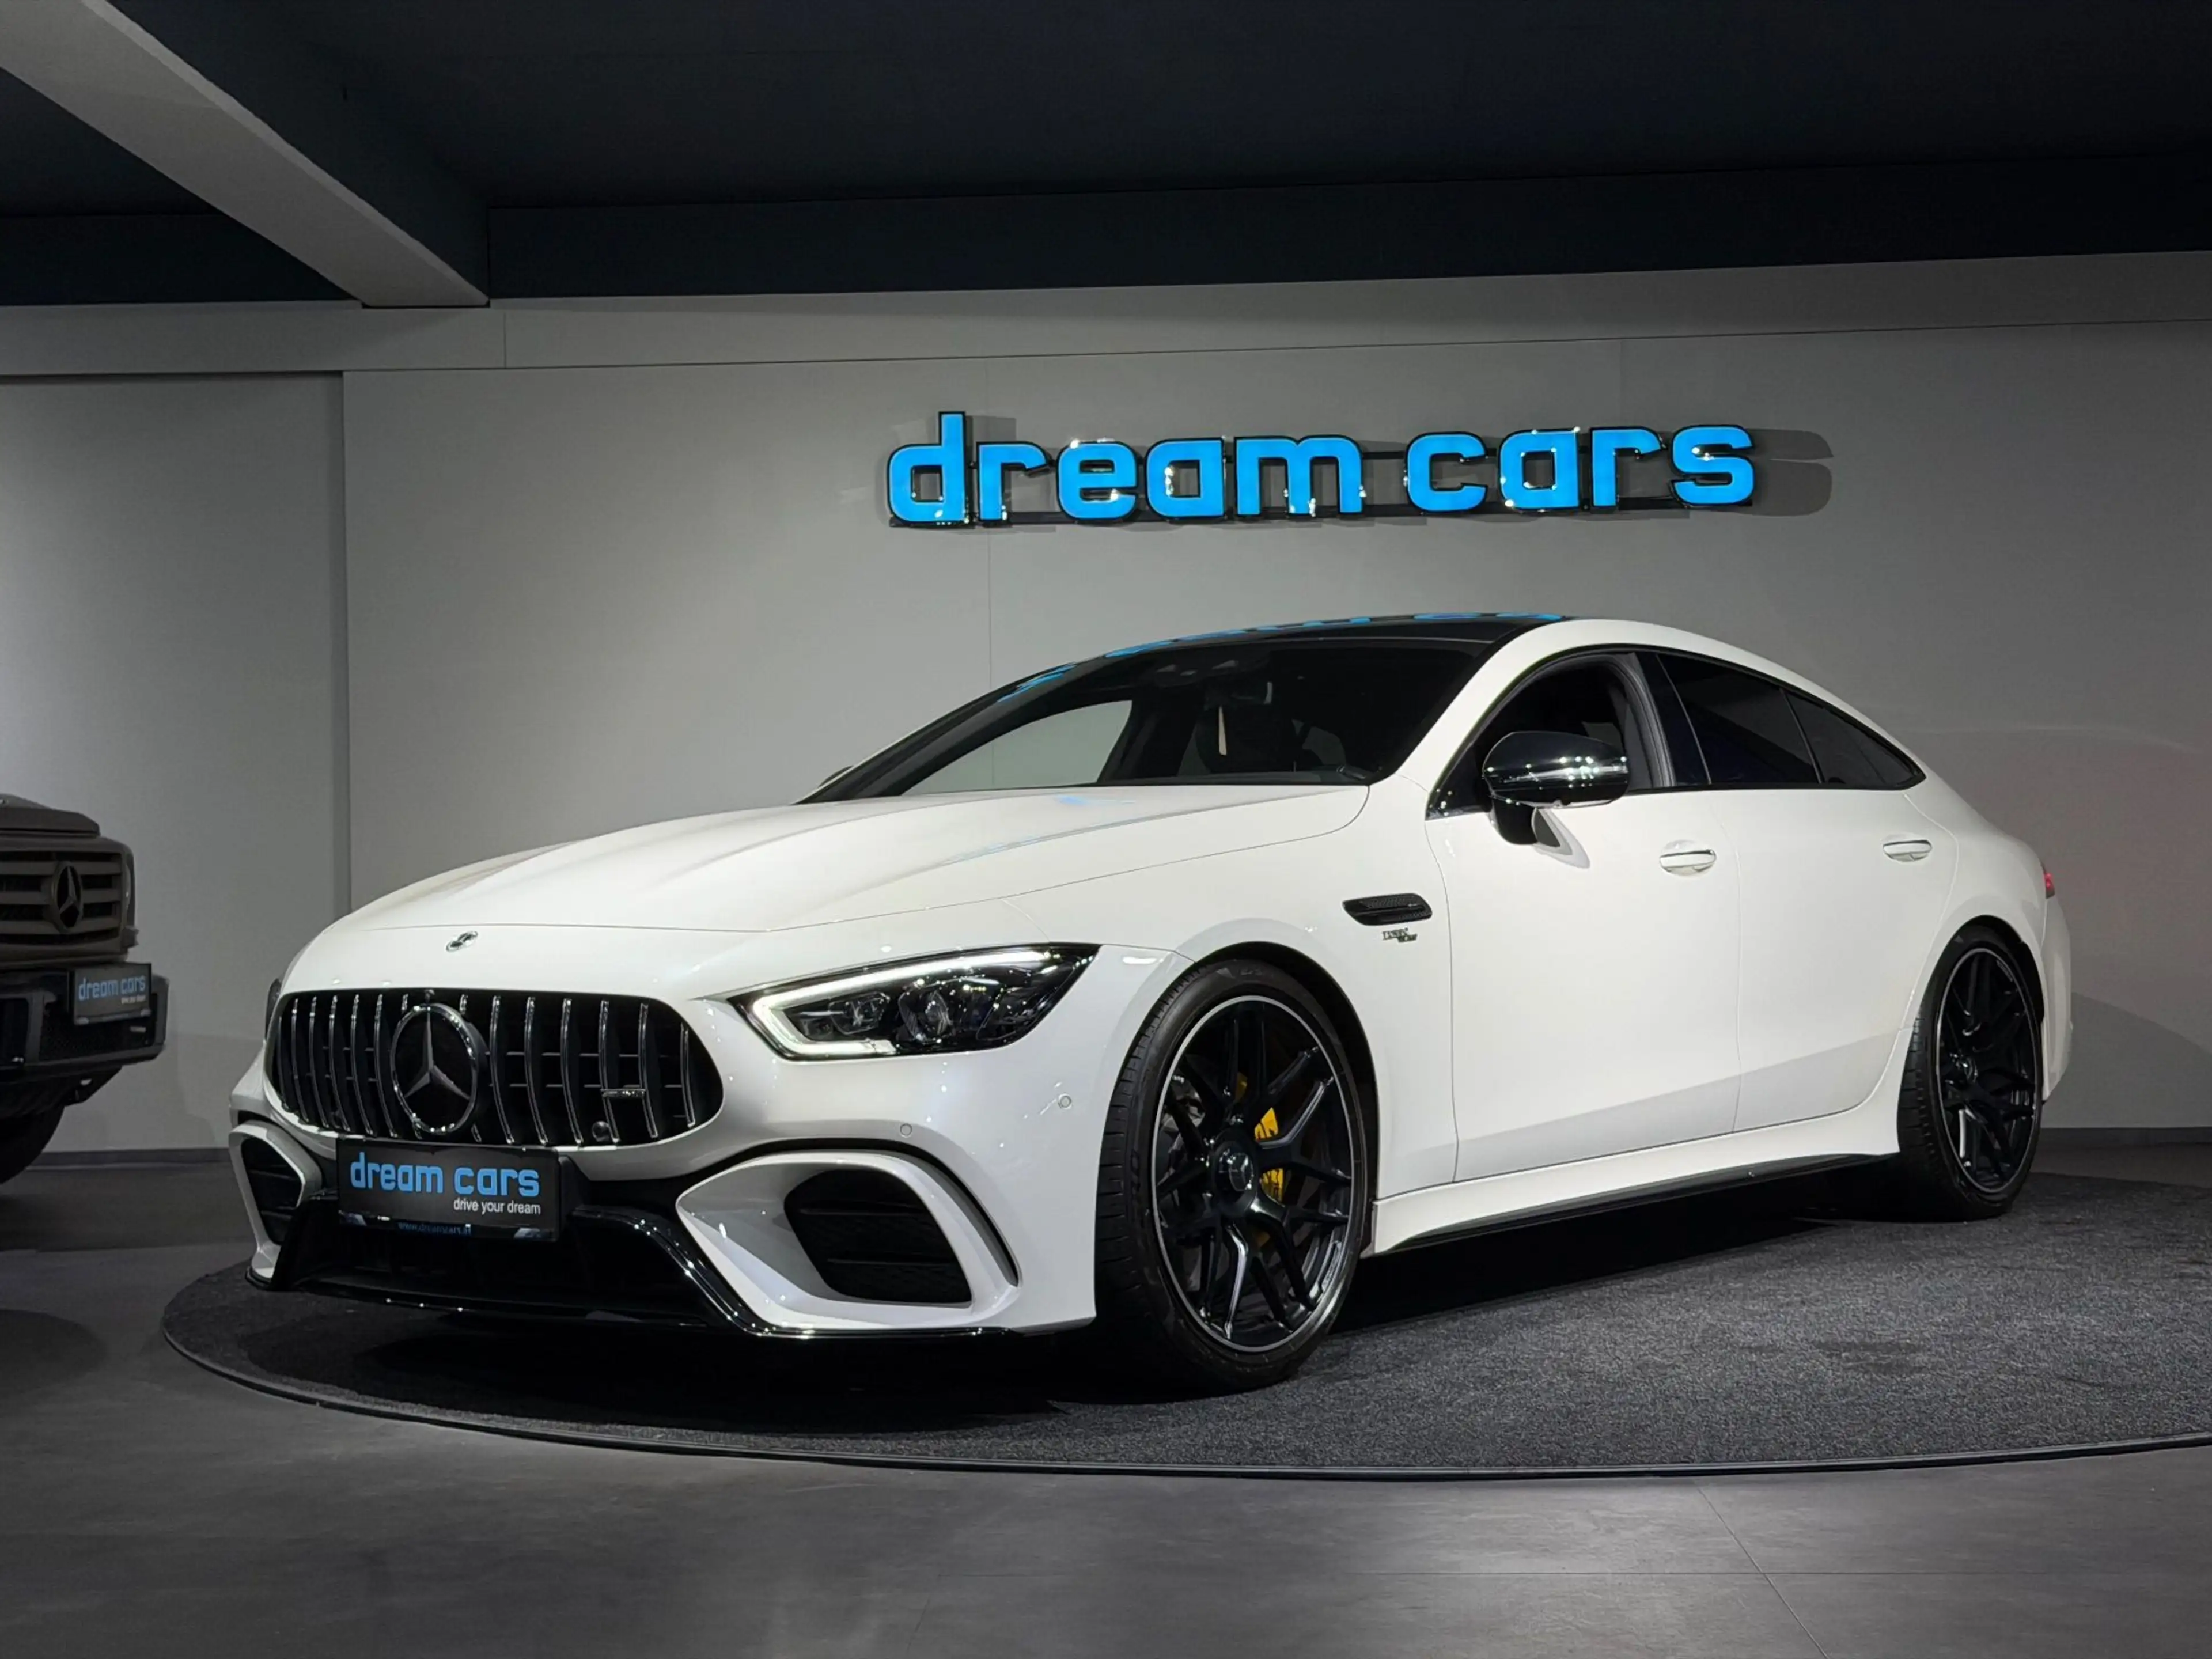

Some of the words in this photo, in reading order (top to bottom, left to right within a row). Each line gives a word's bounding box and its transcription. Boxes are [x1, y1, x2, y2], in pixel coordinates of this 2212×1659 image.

[888, 411, 1363, 524] dream
[1406, 424, 1755, 512] cars
[79, 978, 118, 1001] dream
[122, 975, 146, 994] cars
[350, 1152, 444, 1194] dream
[454, 1167, 540, 1197] cars
[453, 1198, 479, 1211] drive
[481, 1200, 505, 1215] your
[507, 1200, 541, 1214] dream
